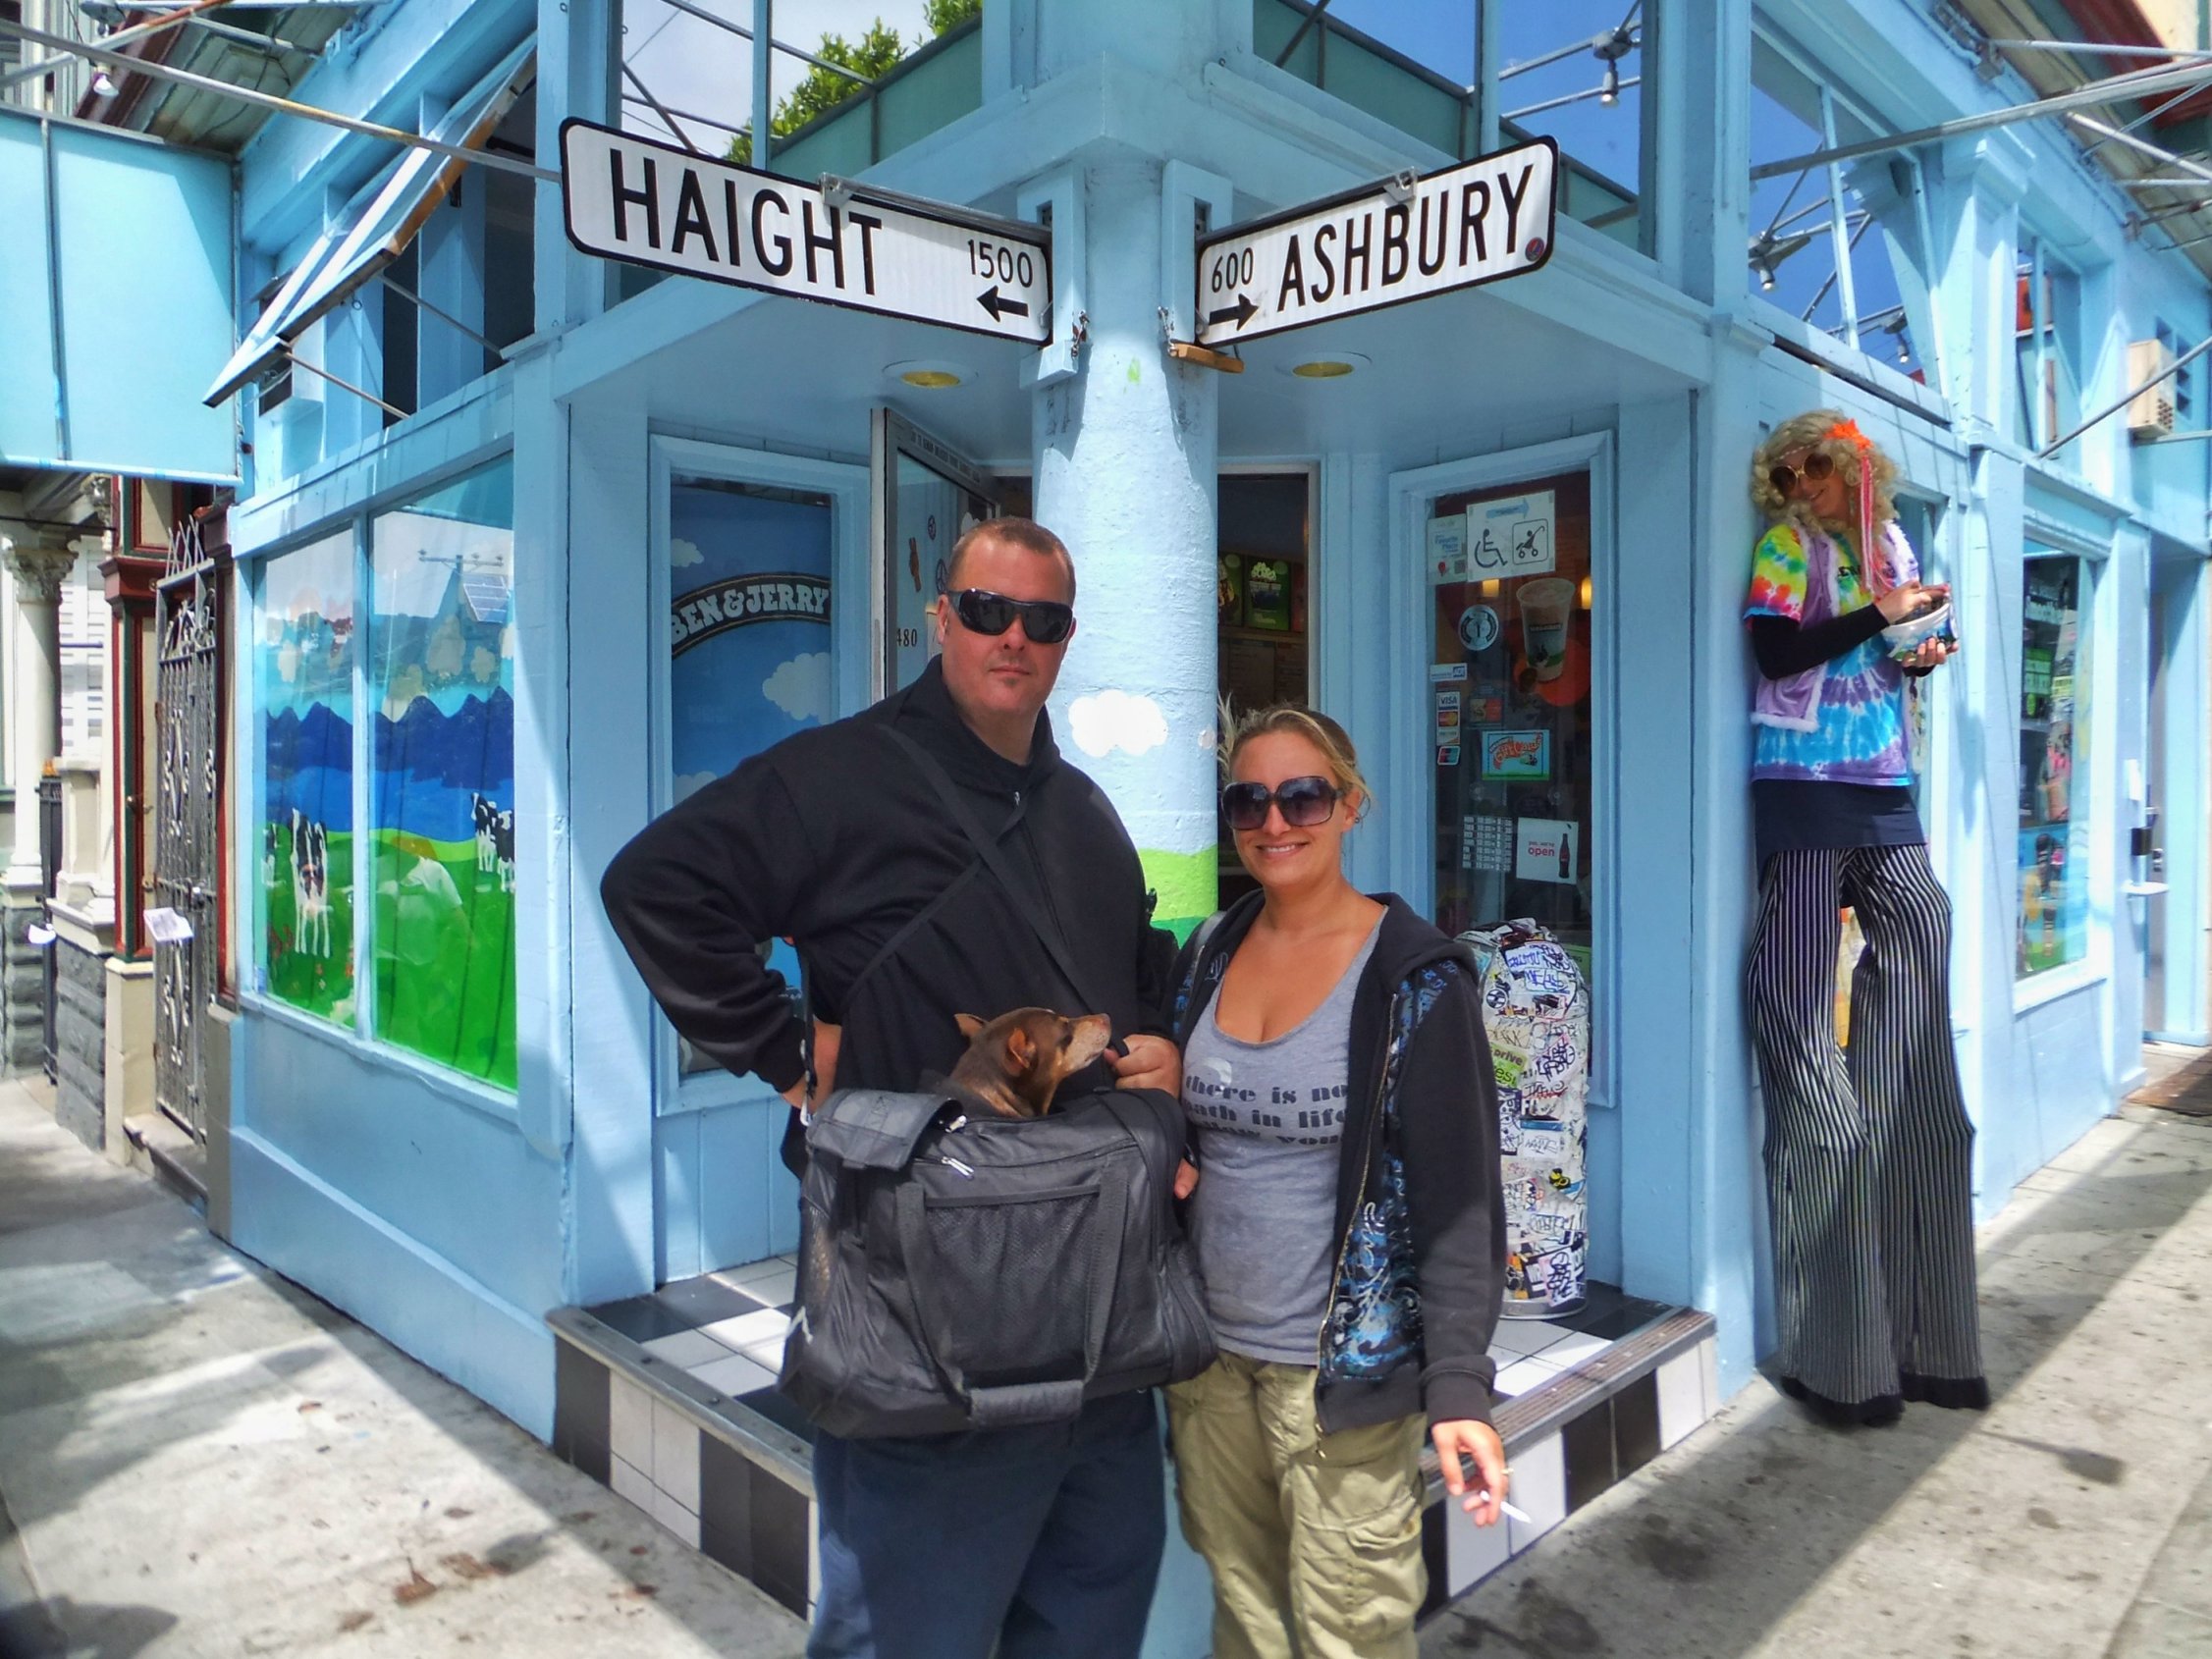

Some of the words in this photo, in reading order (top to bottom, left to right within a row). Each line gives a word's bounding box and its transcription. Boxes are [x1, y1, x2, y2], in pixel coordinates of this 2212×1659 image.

[610, 148, 882, 294] HAIGHT
[1277, 164, 1534, 312] ASHBURY
[967, 239, 1033, 288] 1500
[1212, 246, 1254, 294] 600
[1528, 847, 1555, 857] open
[1185, 1075, 1257, 1102] there
[1271, 1087, 1297, 1104] is
[1312, 1084, 1348, 1102] no
[1252, 1109, 1282, 1128] in
[1299, 1108, 1347, 1128] life
